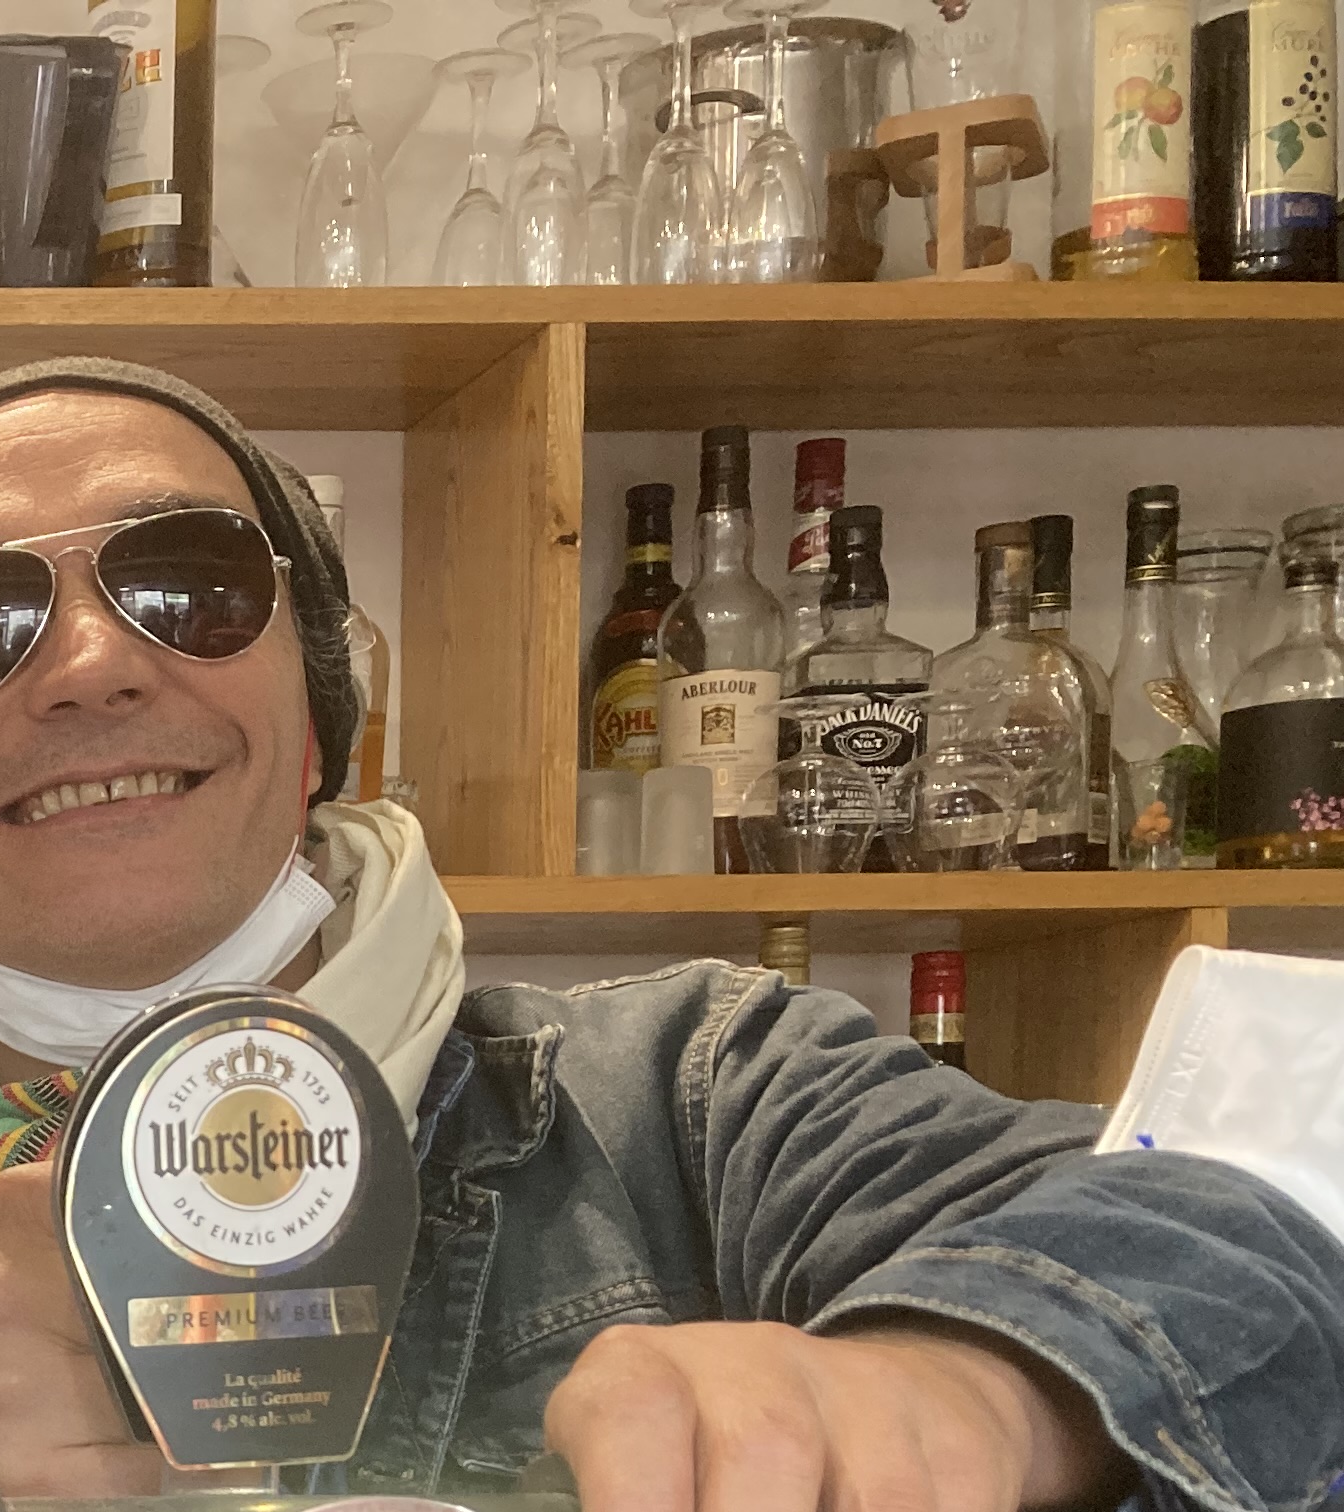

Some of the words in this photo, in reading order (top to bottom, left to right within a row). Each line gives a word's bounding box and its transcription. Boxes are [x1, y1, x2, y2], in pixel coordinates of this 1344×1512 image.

[681, 679, 758, 701] ABERLOUR
[593, 701, 657, 748] KAHL
[168, 1075, 199, 1113] SEIT
[302, 1071, 331, 1105] 1753
[148, 1109, 350, 1181] Warsteiner
[173, 1196, 207, 1228] DAS
[210, 1223, 276, 1246] EINZIG
[282, 1186, 334, 1237] WAHRE
[166, 1307, 282, 1329] PREMIUM
[224, 1373, 245, 1387] La
